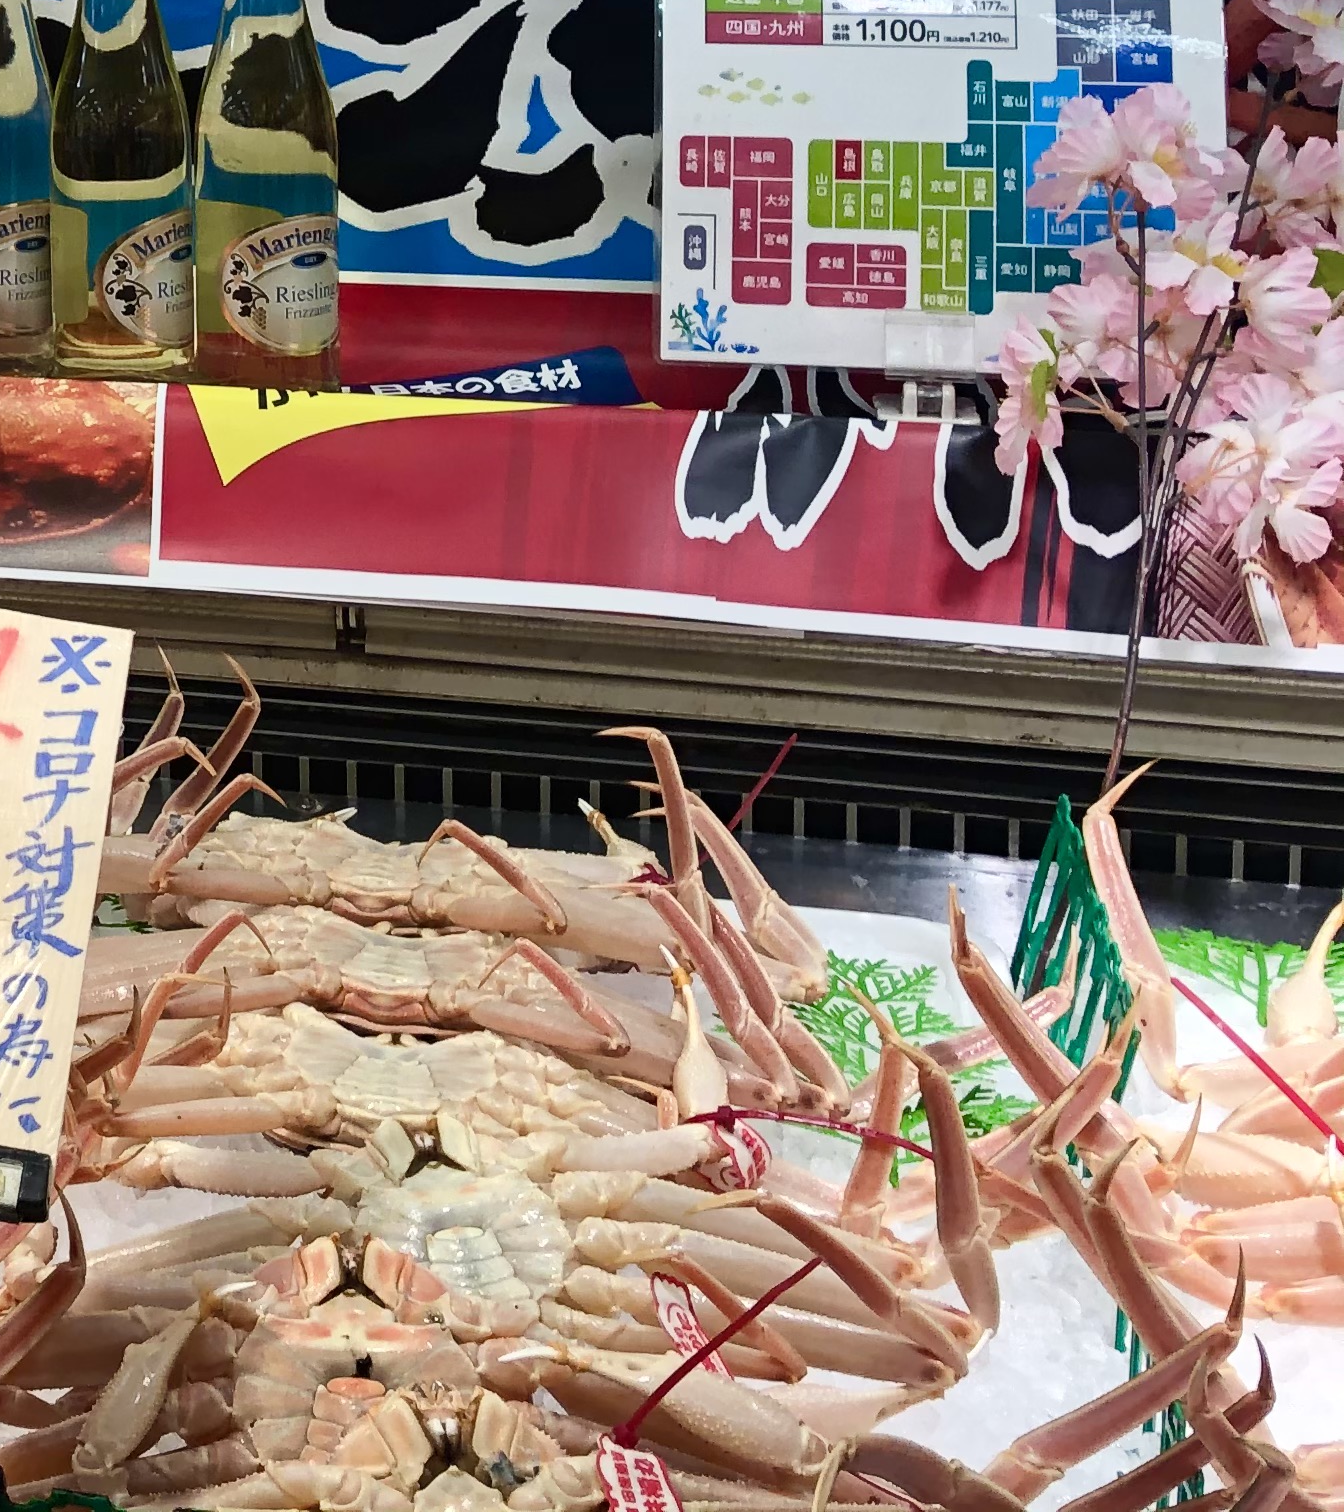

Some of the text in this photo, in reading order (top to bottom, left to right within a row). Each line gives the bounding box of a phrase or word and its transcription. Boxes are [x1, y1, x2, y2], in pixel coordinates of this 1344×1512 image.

[725, 19, 805, 37] 四国・九州
[855, 18, 941, 44] 1,100円
[973, 80, 987, 106] 石川
[1001, 95, 1028, 109] 富山
[749, 150, 776, 165] 福岡
[815, 172, 829, 197] 山口
[929, 179, 957, 193] 京都
[764, 194, 791, 208] 大分
[869, 248, 896, 263] 香川
[974, 255, 988, 282] 三重
[1000, 262, 1029, 277] 愛知
[1043, 264, 1071, 279] 静岡
